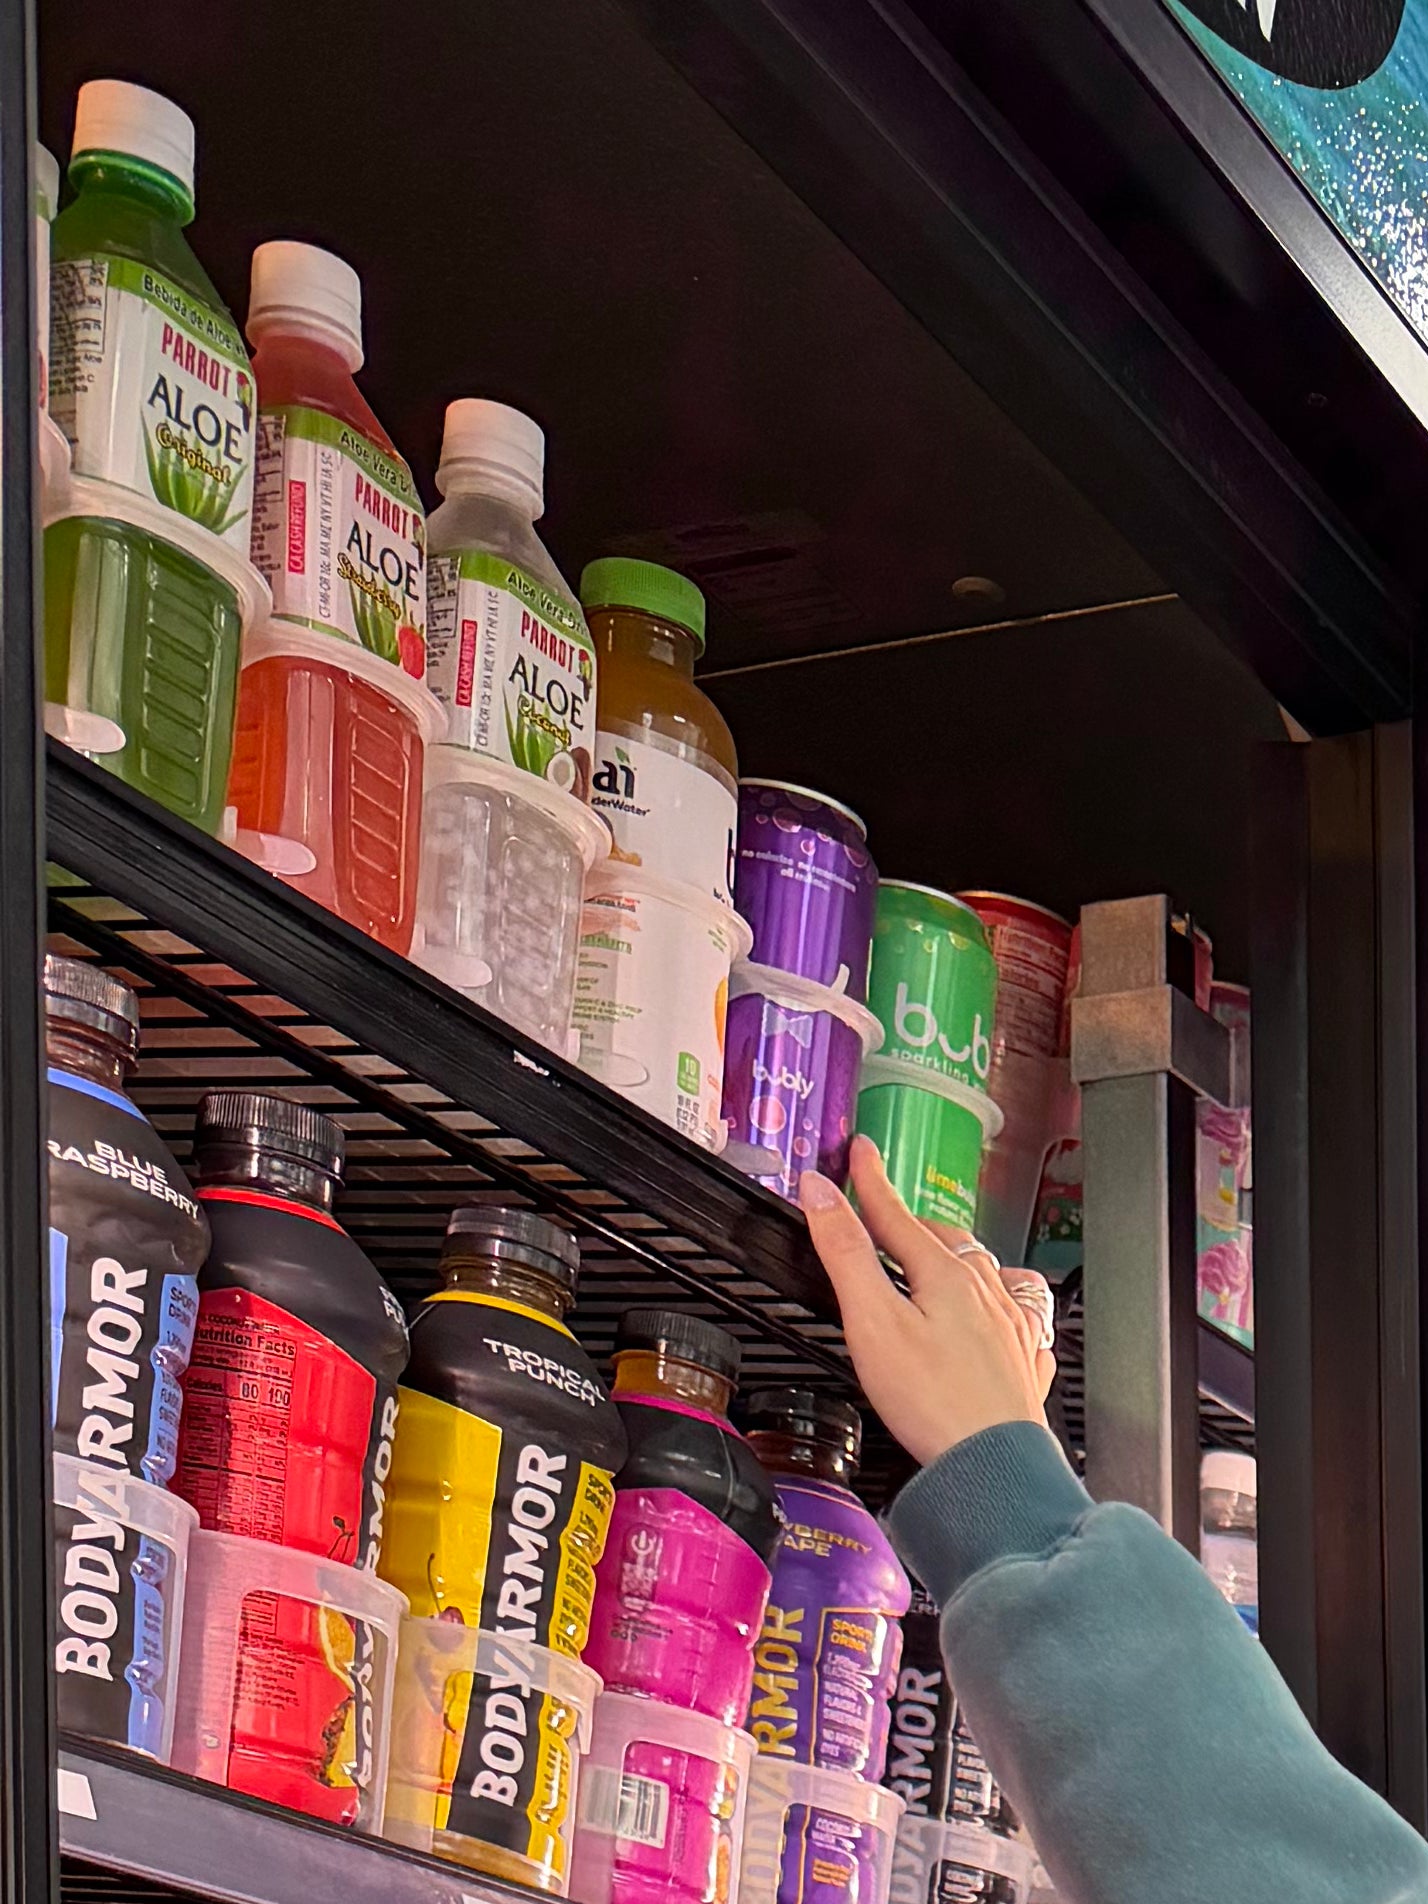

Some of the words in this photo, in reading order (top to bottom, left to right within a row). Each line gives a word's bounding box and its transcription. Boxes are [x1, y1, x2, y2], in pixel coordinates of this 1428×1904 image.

[143, 273, 188, 319] Bebida
[189, 307, 204, 332] de
[206, 318, 232, 351] Aloe
[161, 321, 232, 398] PARROT
[147, 372, 244, 465] ALOE
[155, 421, 233, 486] Original
[340, 429, 371, 463] Aloe
[372, 449, 398, 485] Vera
[355, 471, 410, 540] PARROT
[346, 519, 420, 602] ALOE
[506, 569, 537, 599] Aloe
[521, 609, 576, 673] PARROT
[508, 652, 584, 730] ALOE
[752, 1059, 815, 1100] bubly
[889, 1048, 971, 1084] sparkling
[94, 1140, 168, 1185] BLUE
[195, 1327, 253, 1349] utrition
[257, 1335, 297, 1357] Facts
[482, 1337, 606, 1402] TROPICAL
[508, 1360, 597, 1408] PUNCH
[55, 1255, 148, 1682] BODYARMOR
[783, 1535, 832, 1558] APE
[471, 1443, 568, 1808] BODYARMOR
